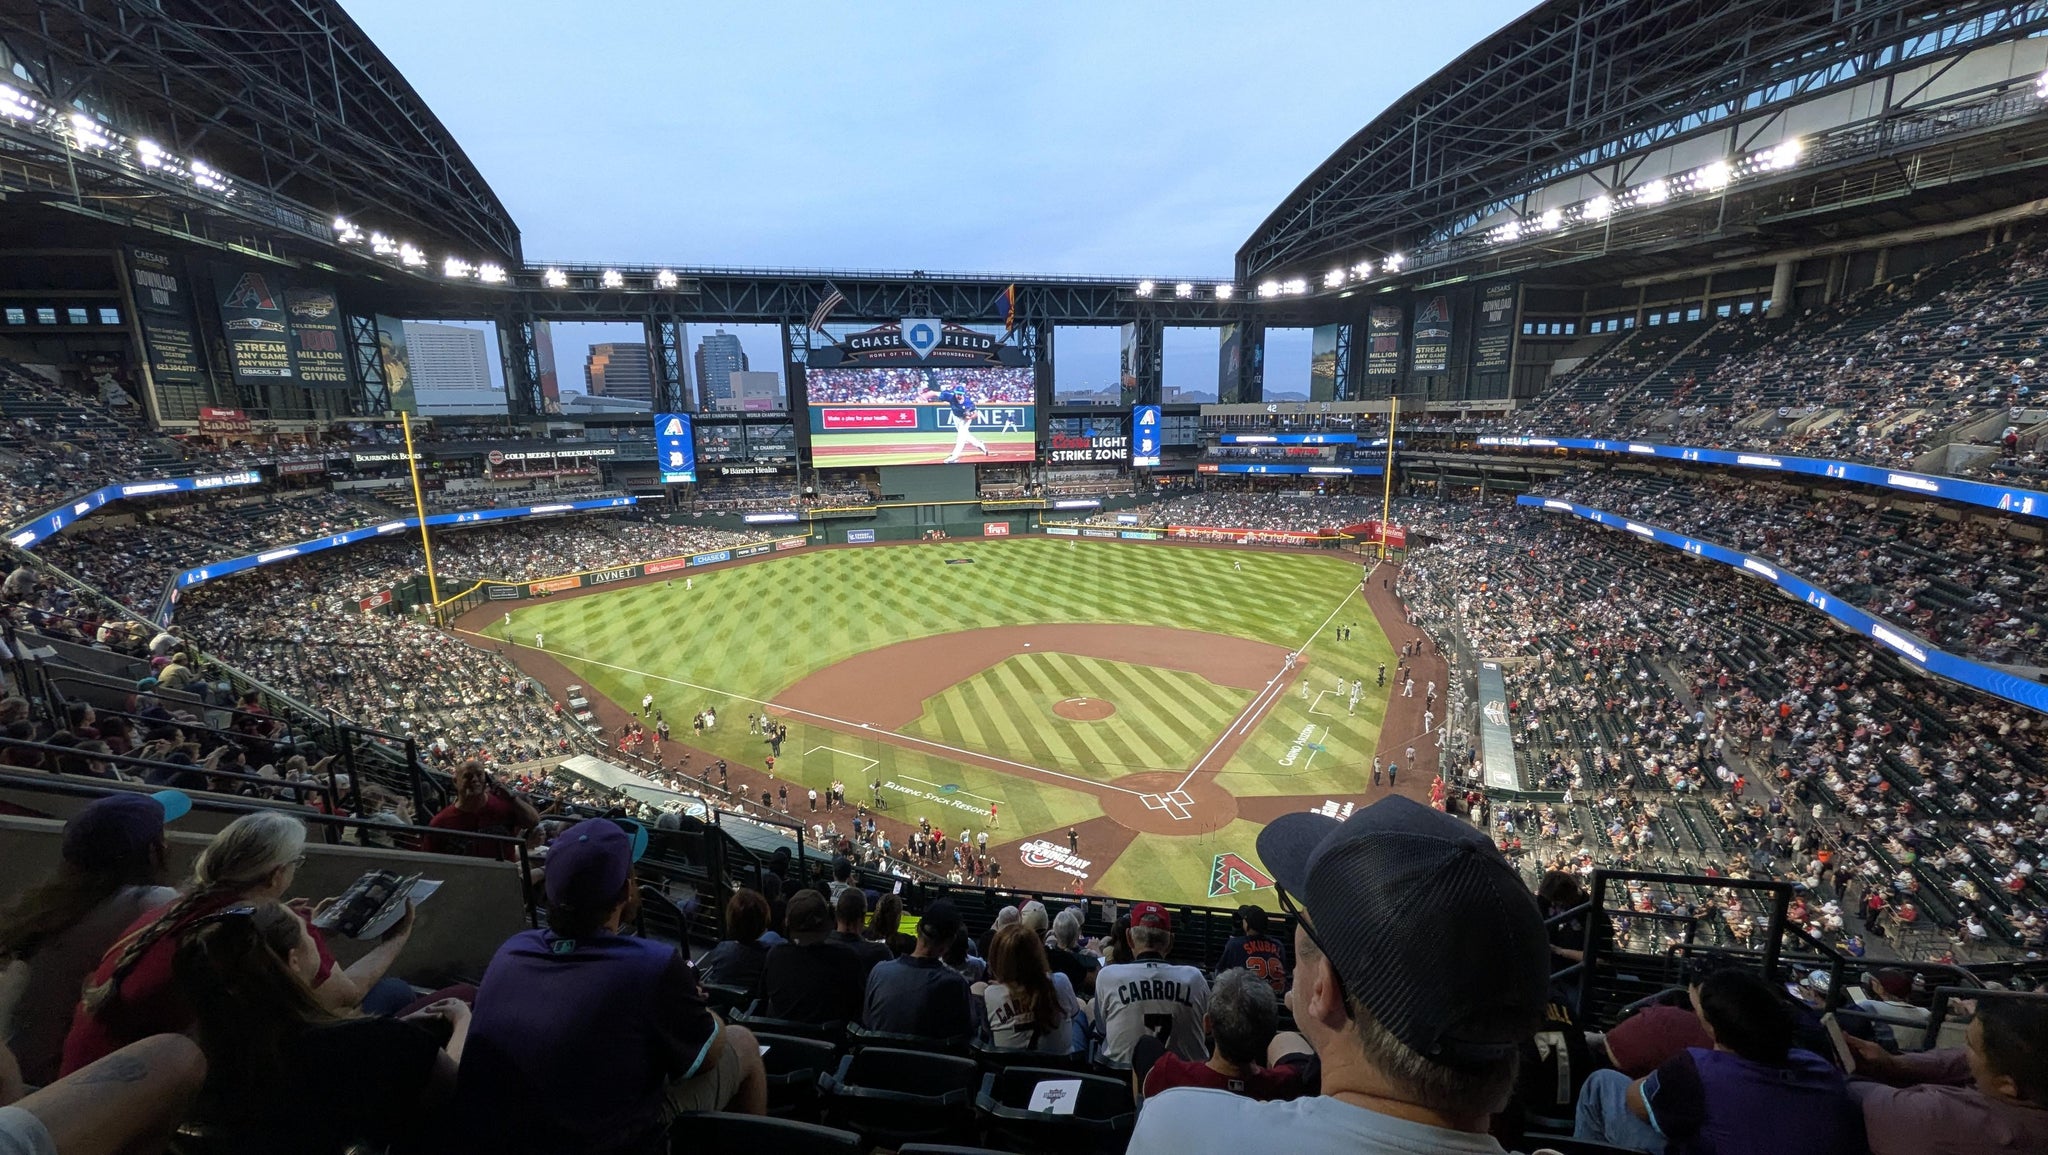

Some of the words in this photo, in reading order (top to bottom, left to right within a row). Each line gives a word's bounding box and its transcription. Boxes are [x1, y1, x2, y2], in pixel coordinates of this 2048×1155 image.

[135, 250, 169, 265] CAESARS
[135, 269, 177, 292] DOWNLOAD
[151, 288, 169, 306] NOW
[1482, 298, 1512, 312] DOWNLOAD
[235, 342, 286, 353] STREAM
[851, 336, 899, 349] CHASE
[946, 336, 991, 349] FIELD
[237, 352, 259, 360] ANY
[297, 351, 342, 359] MILLION
[238, 360, 290, 368] ANYWHERE
[302, 373, 347, 381] GIVING
[1267, 404, 1277, 412] 42
[1092, 437, 1127, 448] LIGHT
[356, 454, 391, 462] BOURBON
[557, 449, 615, 458] CHEESEBURGERS
[1052, 450, 1092, 461] STRIKE
[1095, 449, 1128, 460] ZONE
[755, 466, 778, 474] Health
[698, 554, 720, 563] CHASE
[596, 569, 631, 582] AVNET
[1293, 724, 1316, 746] ARIZONA
[1278, 745, 1302, 766] CASINO
[884, 781, 922, 797] TALKING
[923, 792, 951, 805] STICK
[950, 800, 992, 816] RESORT
[1020, 842, 1069, 862] OPENING
[1064, 856, 1091, 869] DAY
[1054, 865, 1088, 879] Adobe
[1118, 980, 1193, 1008] CARROLL
